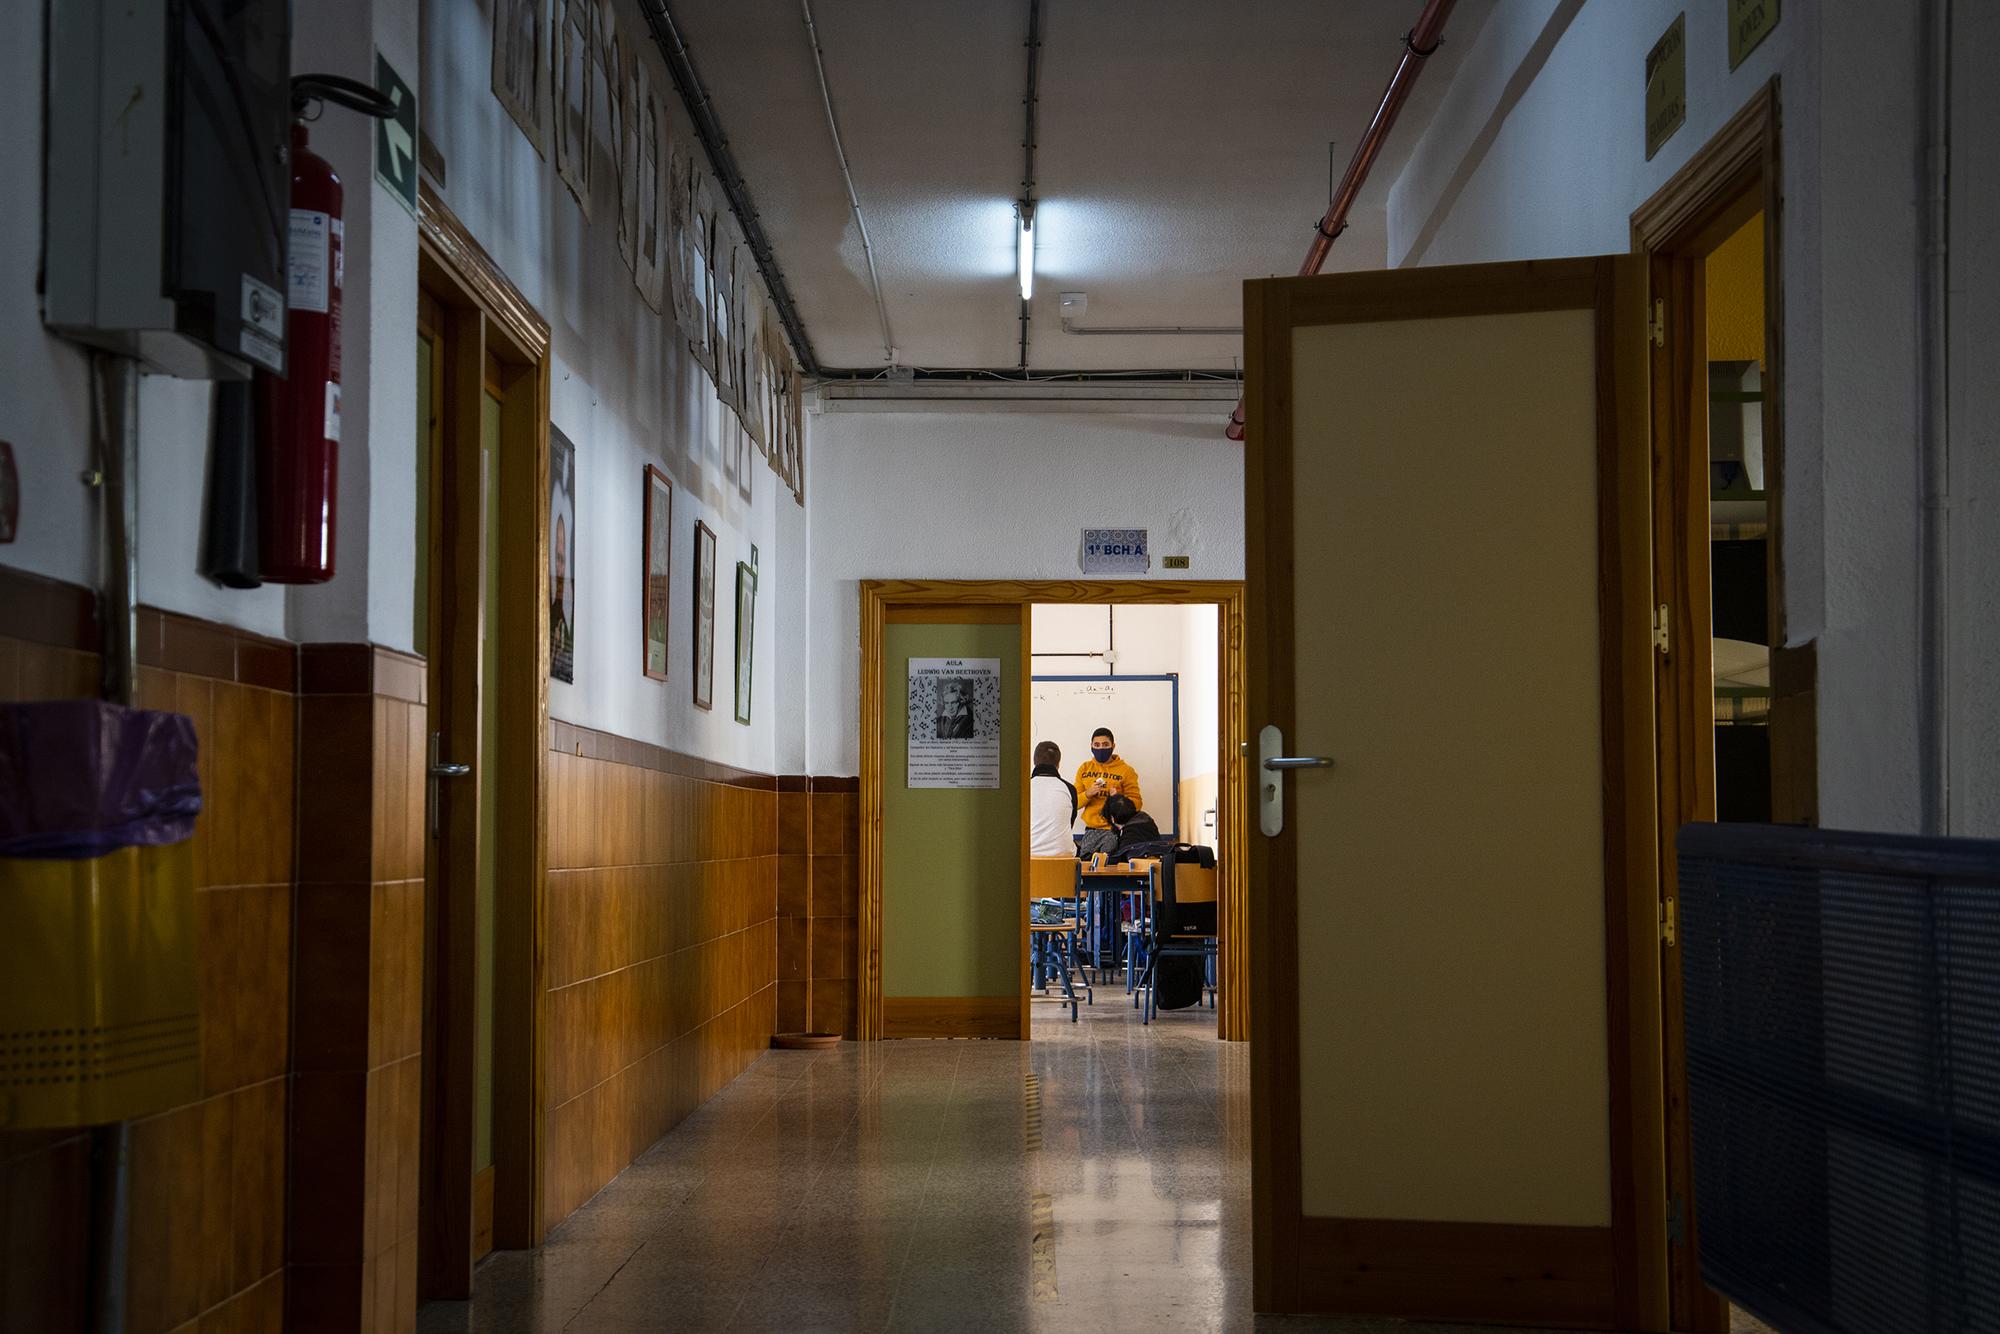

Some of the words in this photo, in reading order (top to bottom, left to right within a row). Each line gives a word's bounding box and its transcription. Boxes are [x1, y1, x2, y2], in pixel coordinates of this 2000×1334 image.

[1103, 544, 1130, 555] BCH
[1134, 544, 1144, 555] A
[1168, 558, 1186, 567] 108
[1102, 772, 1123, 781] STOP
